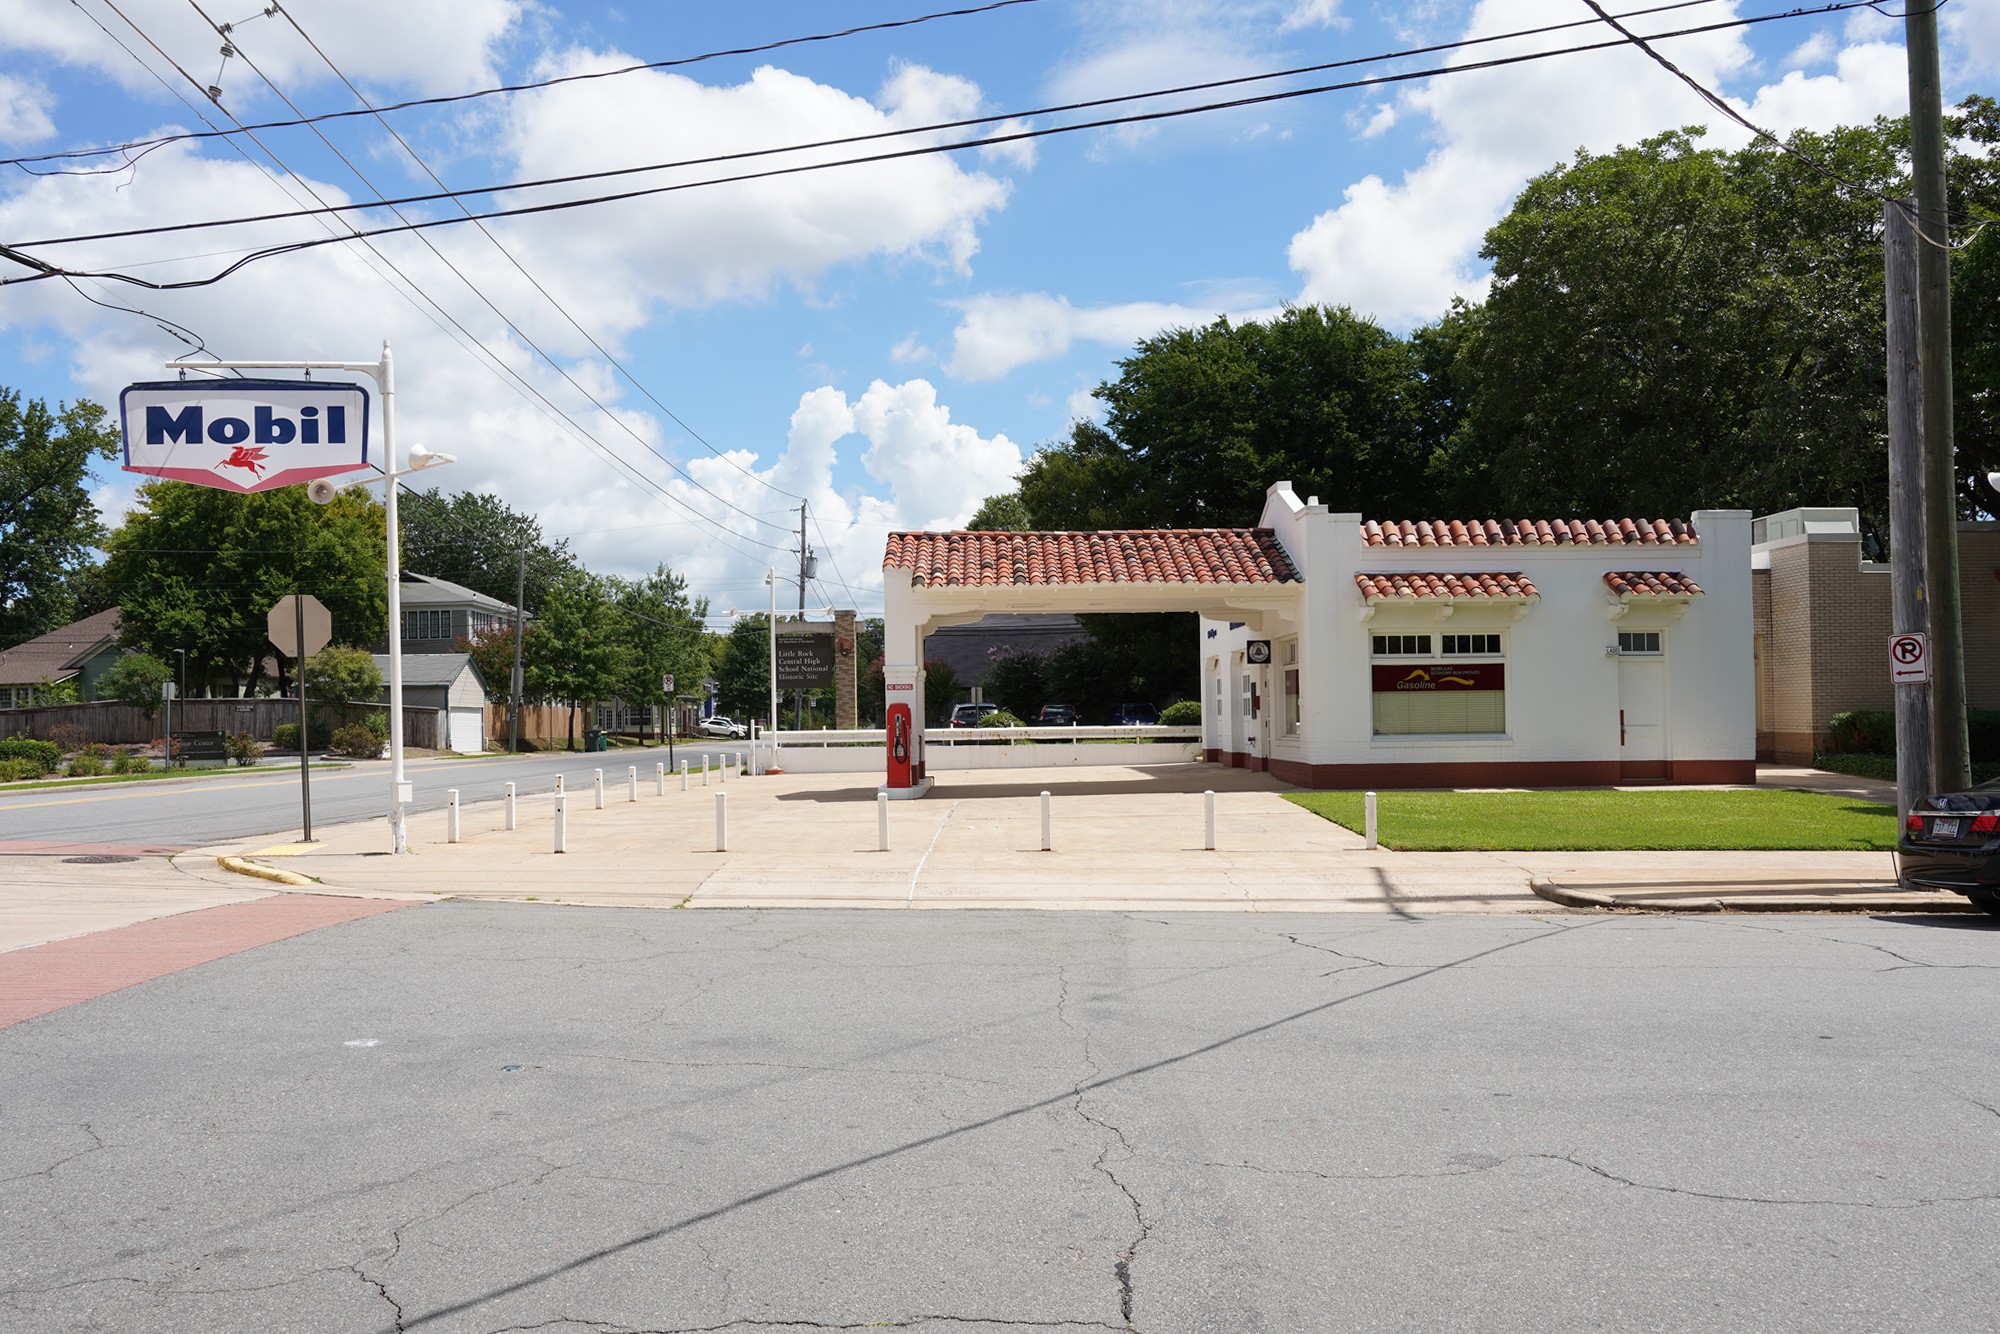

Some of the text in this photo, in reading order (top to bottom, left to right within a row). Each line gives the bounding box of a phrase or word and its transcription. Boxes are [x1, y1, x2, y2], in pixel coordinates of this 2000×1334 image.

[146, 406, 345, 445] Mobil
[804, 658, 821, 666] High
[1396, 680, 1436, 690] Gasoline
